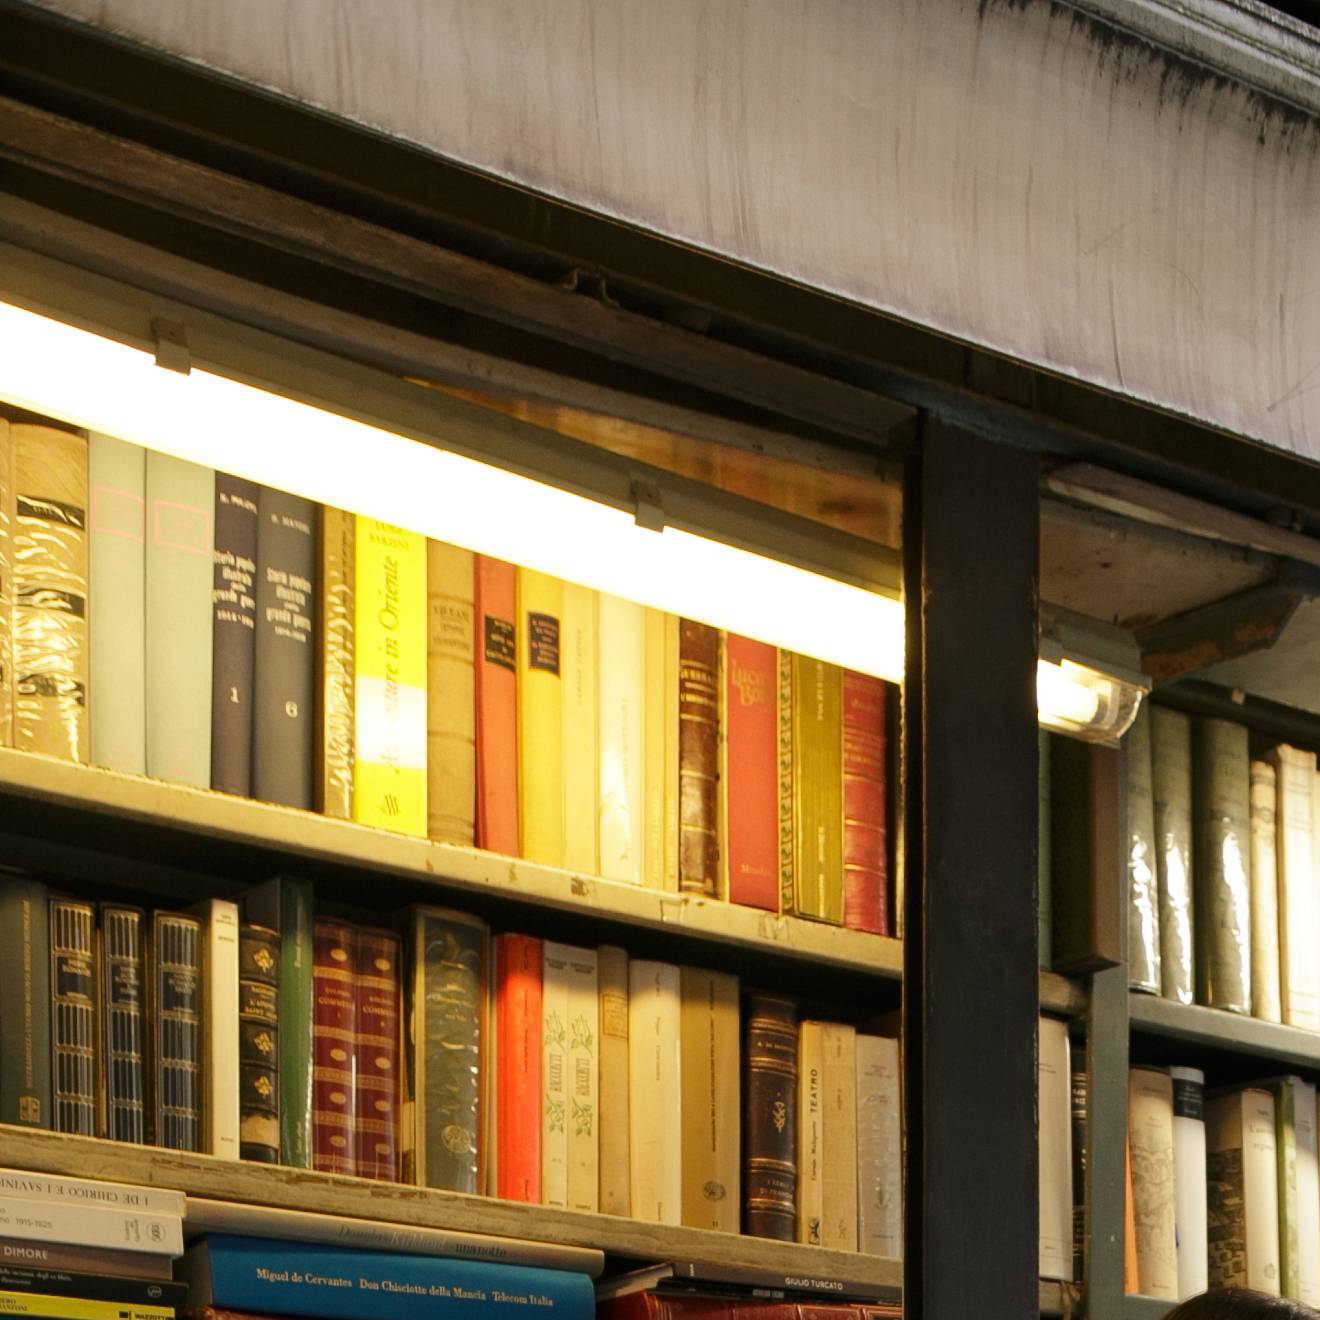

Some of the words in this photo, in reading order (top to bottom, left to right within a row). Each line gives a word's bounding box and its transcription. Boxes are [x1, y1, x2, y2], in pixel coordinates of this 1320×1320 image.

[377, 555, 399, 631] Oriente
[377, 638, 398, 657] in
[230, 686, 240, 703] 1
[285, 701, 298, 718] 6
[69, 1189, 118, 1201] CHIRICO
[3, 1246, 48, 1260] DIMORE
[257, 1268, 289, 1283] Miguel
[292, 1272, 302, 1283] de
[305, 1274, 352, 1287] Cervantes
[360, 1278, 379, 1290] Don
[381, 1281, 427, 1295] Chisciotte
[429, 1286, 451, 1298] della
[453, 1288, 486, 1301] Mancia
[493, 1291, 527, 1305] Telecom
[530, 1295, 554, 1307] Italia
[785, 1277, 810, 1287] GIULIO
[811, 1279, 843, 1290] TURCATO
